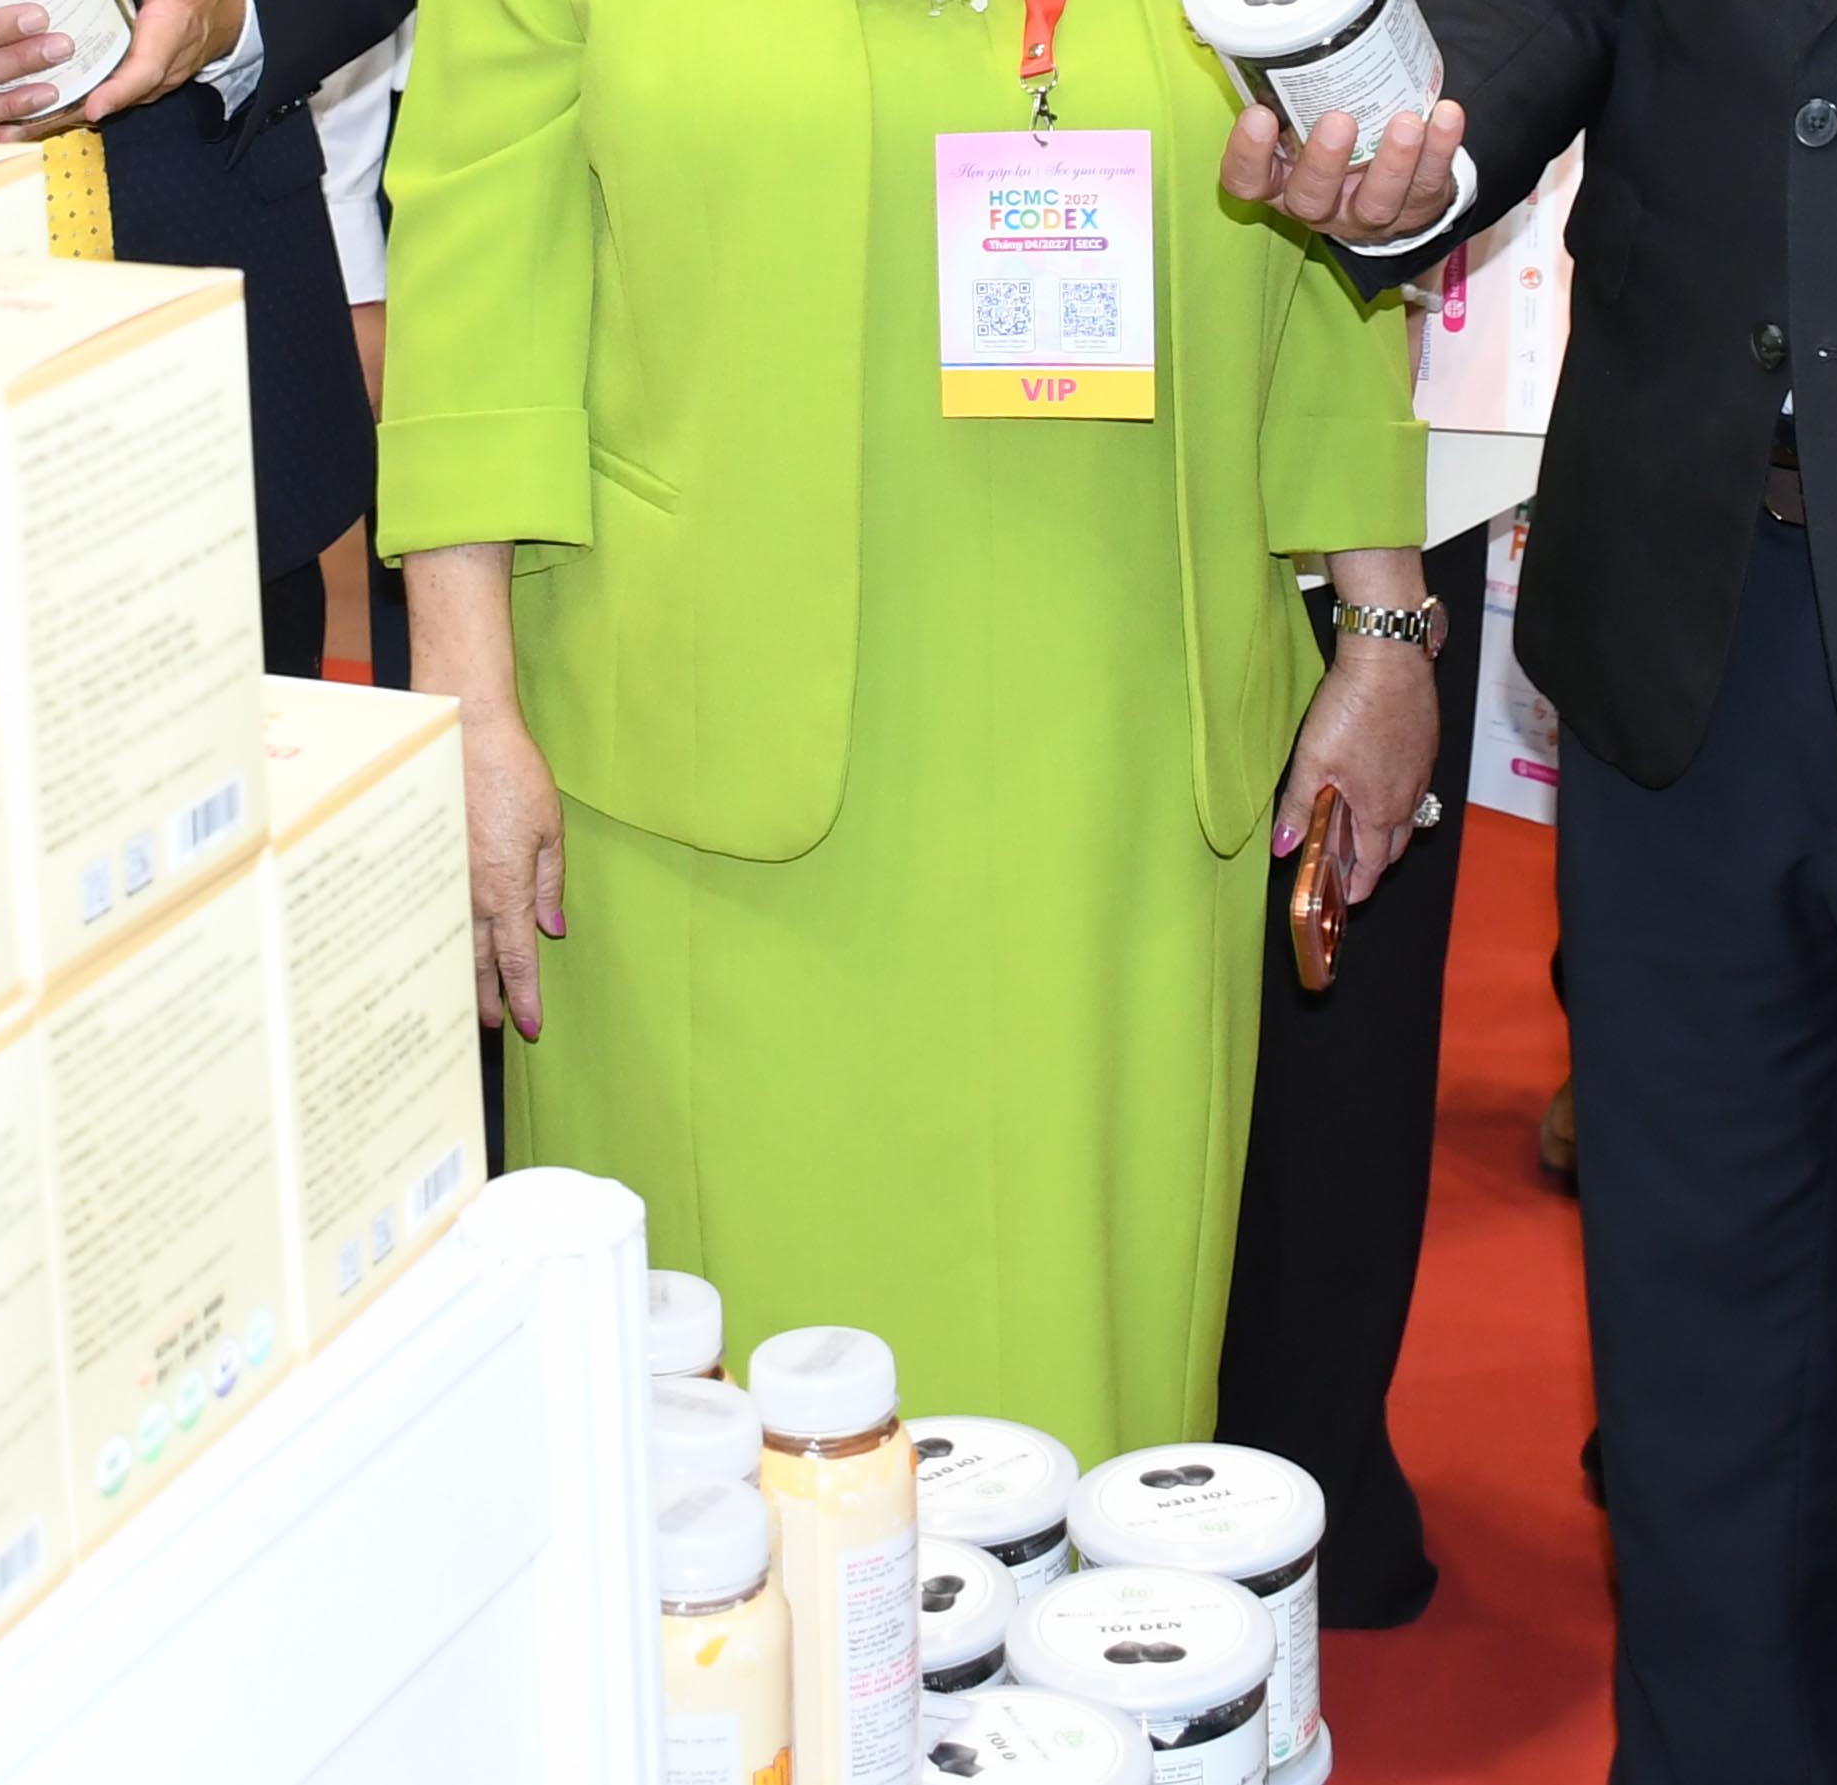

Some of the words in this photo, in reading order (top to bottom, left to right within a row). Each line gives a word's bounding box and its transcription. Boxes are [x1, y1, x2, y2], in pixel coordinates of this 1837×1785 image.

[989, 189, 1059, 206] HCMC
[1064, 194, 1099, 205] 2027
[1024, 238, 1068, 249] 04/2027
[1075, 238, 1104, 249] SECC
[1020, 378, 1077, 402] VIP
